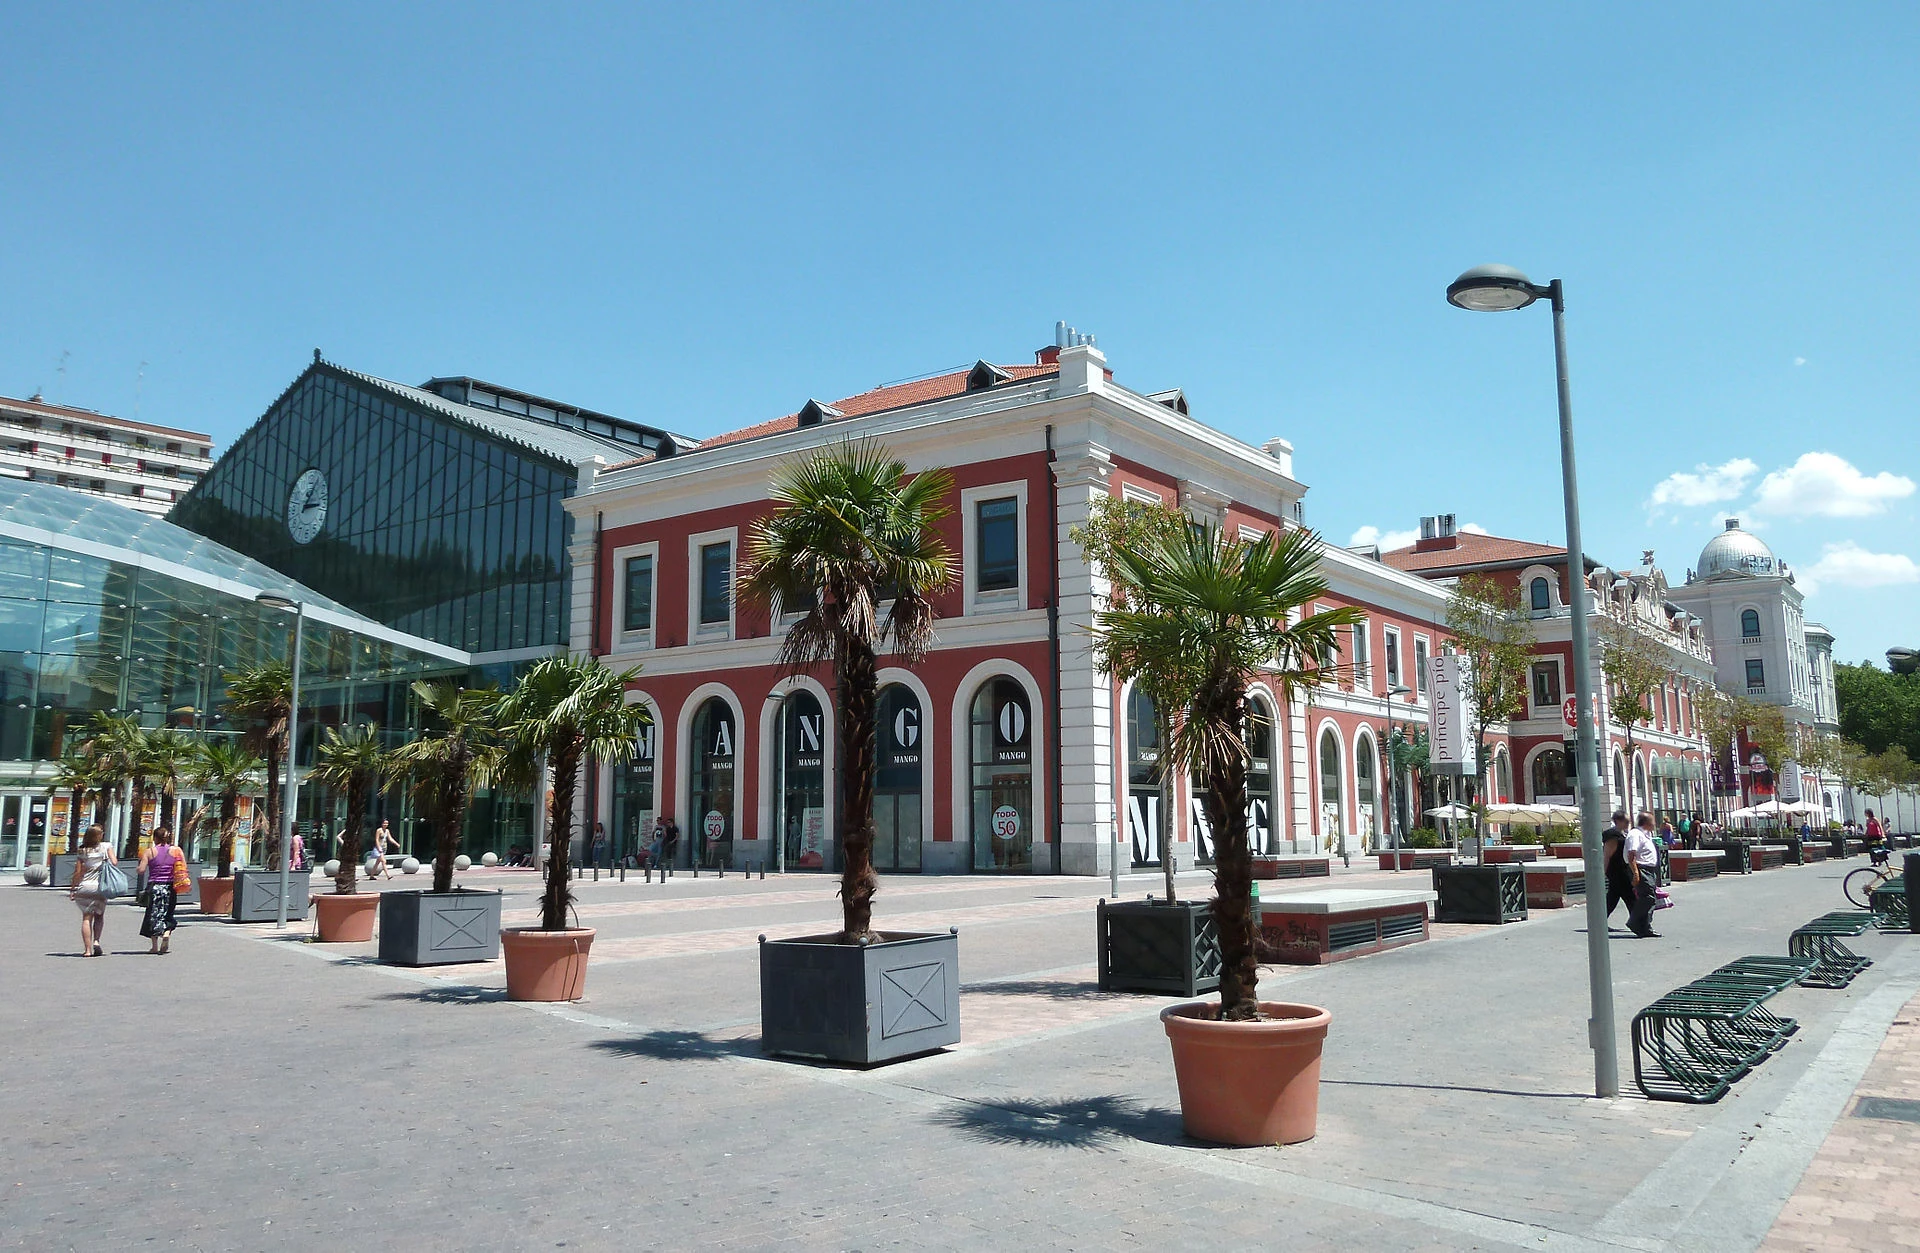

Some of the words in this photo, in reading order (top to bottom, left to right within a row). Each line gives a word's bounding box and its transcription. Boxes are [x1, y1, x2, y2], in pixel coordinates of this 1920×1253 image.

[1433, 657, 1449, 683] pio
[714, 721, 732, 755] A
[799, 715, 821, 751] N
[895, 707, 918, 747] G
[1000, 701, 1024, 743] O
[894, 755, 918, 763] MANGO
[999, 752, 1026, 760] MANGO
[708, 823, 721, 836] 50
[998, 820, 1016, 836] 50
